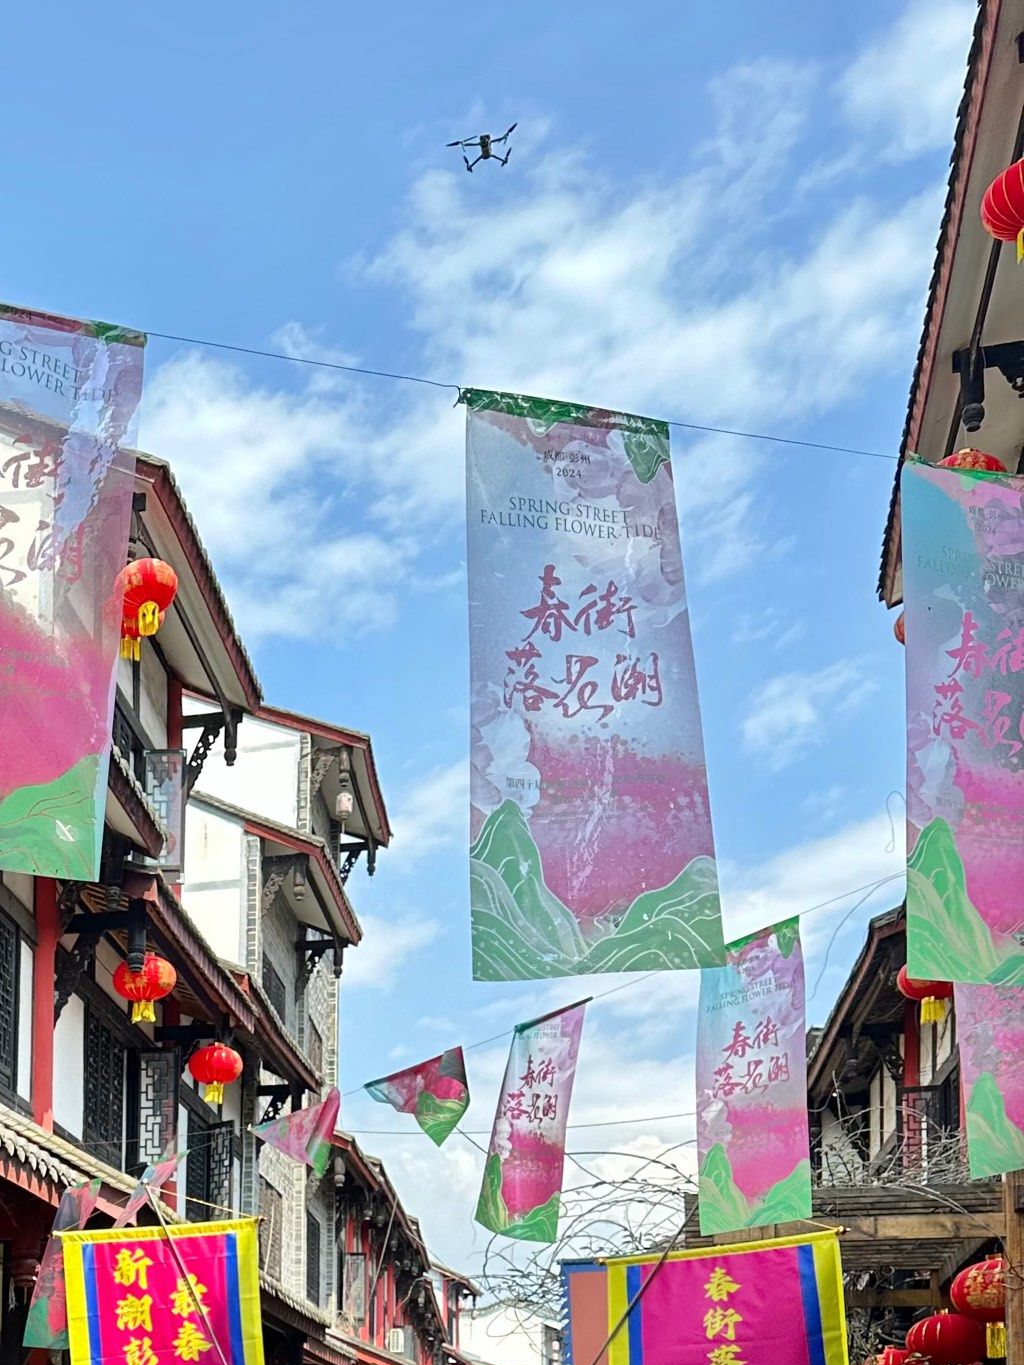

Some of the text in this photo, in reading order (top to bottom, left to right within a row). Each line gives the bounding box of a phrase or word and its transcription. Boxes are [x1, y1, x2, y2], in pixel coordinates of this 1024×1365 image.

[19, 346, 83, 384] STREET
[555, 466, 582, 479] 2024
[480, 509, 662, 541] FALLING FLOWER TIDE
[508, 496, 630, 526] SPRING STREET
[519, 564, 638, 642] 春街
[933, 677, 1024, 757] 落花
[721, 1016, 779, 1064] 春街
[518, 1054, 556, 1091] 春街
